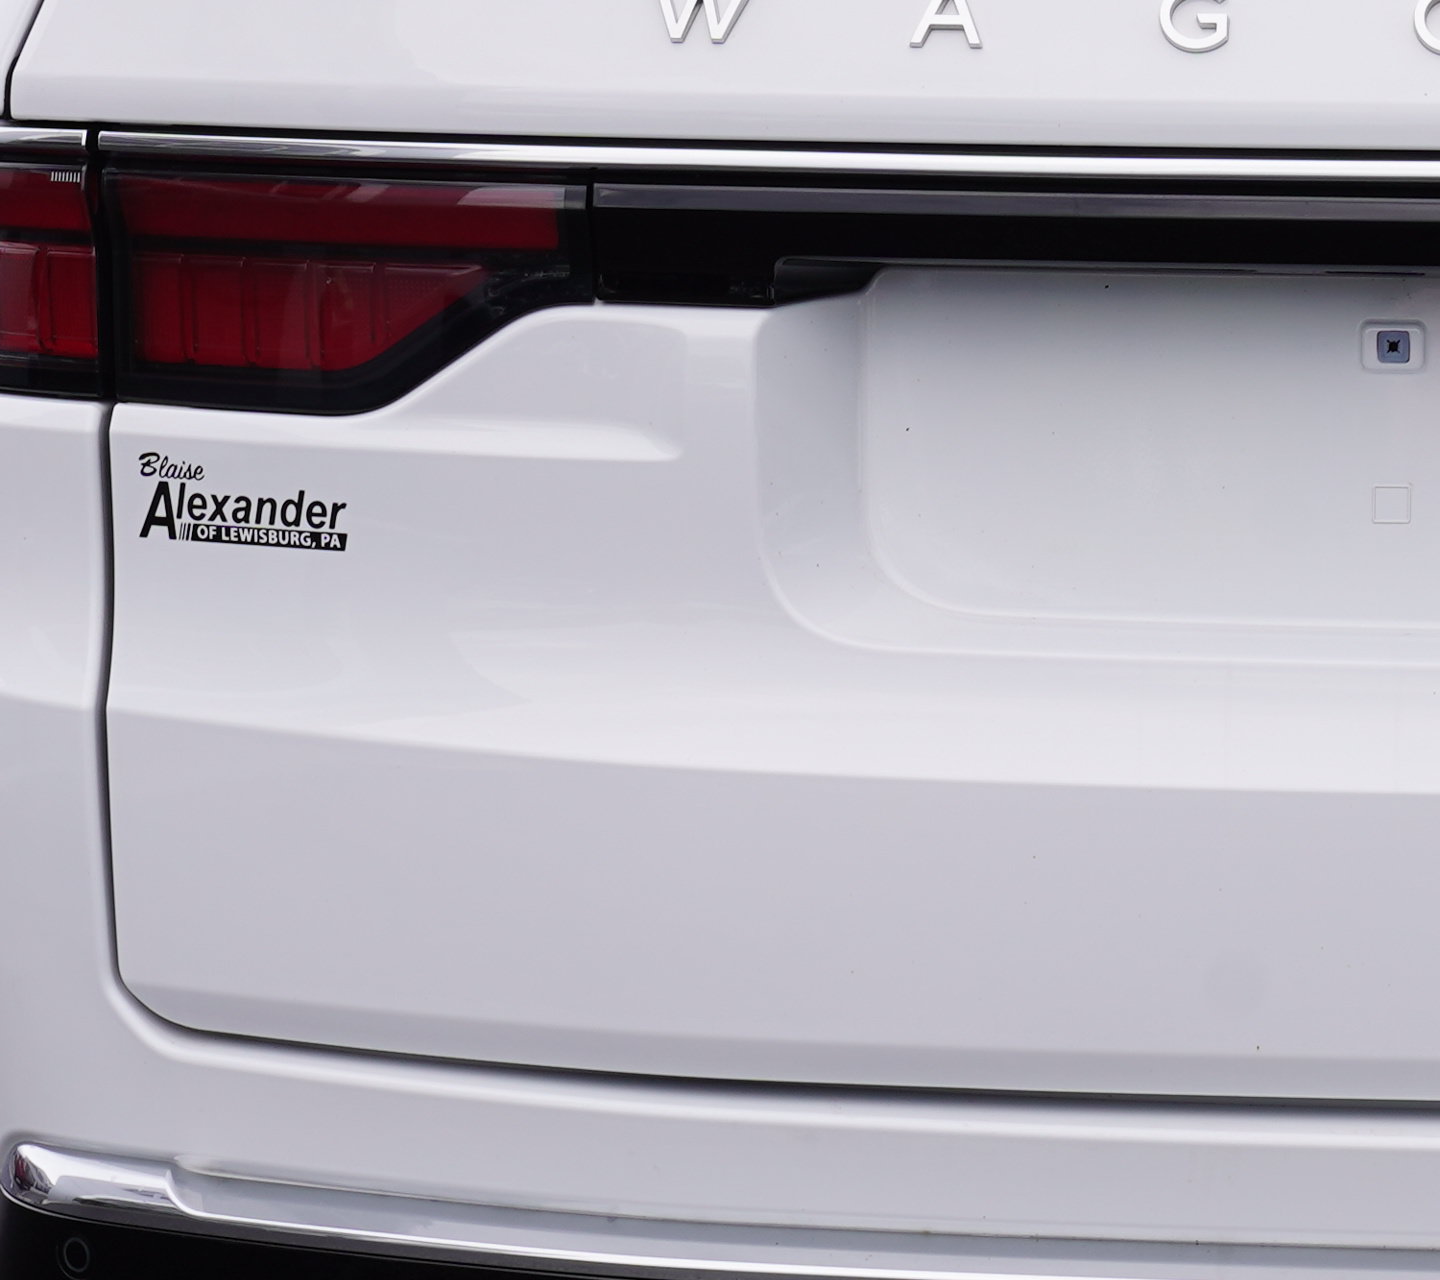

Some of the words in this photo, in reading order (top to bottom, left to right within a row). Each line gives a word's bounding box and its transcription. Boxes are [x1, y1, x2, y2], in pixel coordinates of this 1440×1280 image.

[138, 452, 205, 481] Blaise
[139, 480, 347, 540] Alexander
[196, 525, 218, 540] OF
[221, 525, 317, 549] LEWISBURG,
[320, 533, 341, 548] PA
